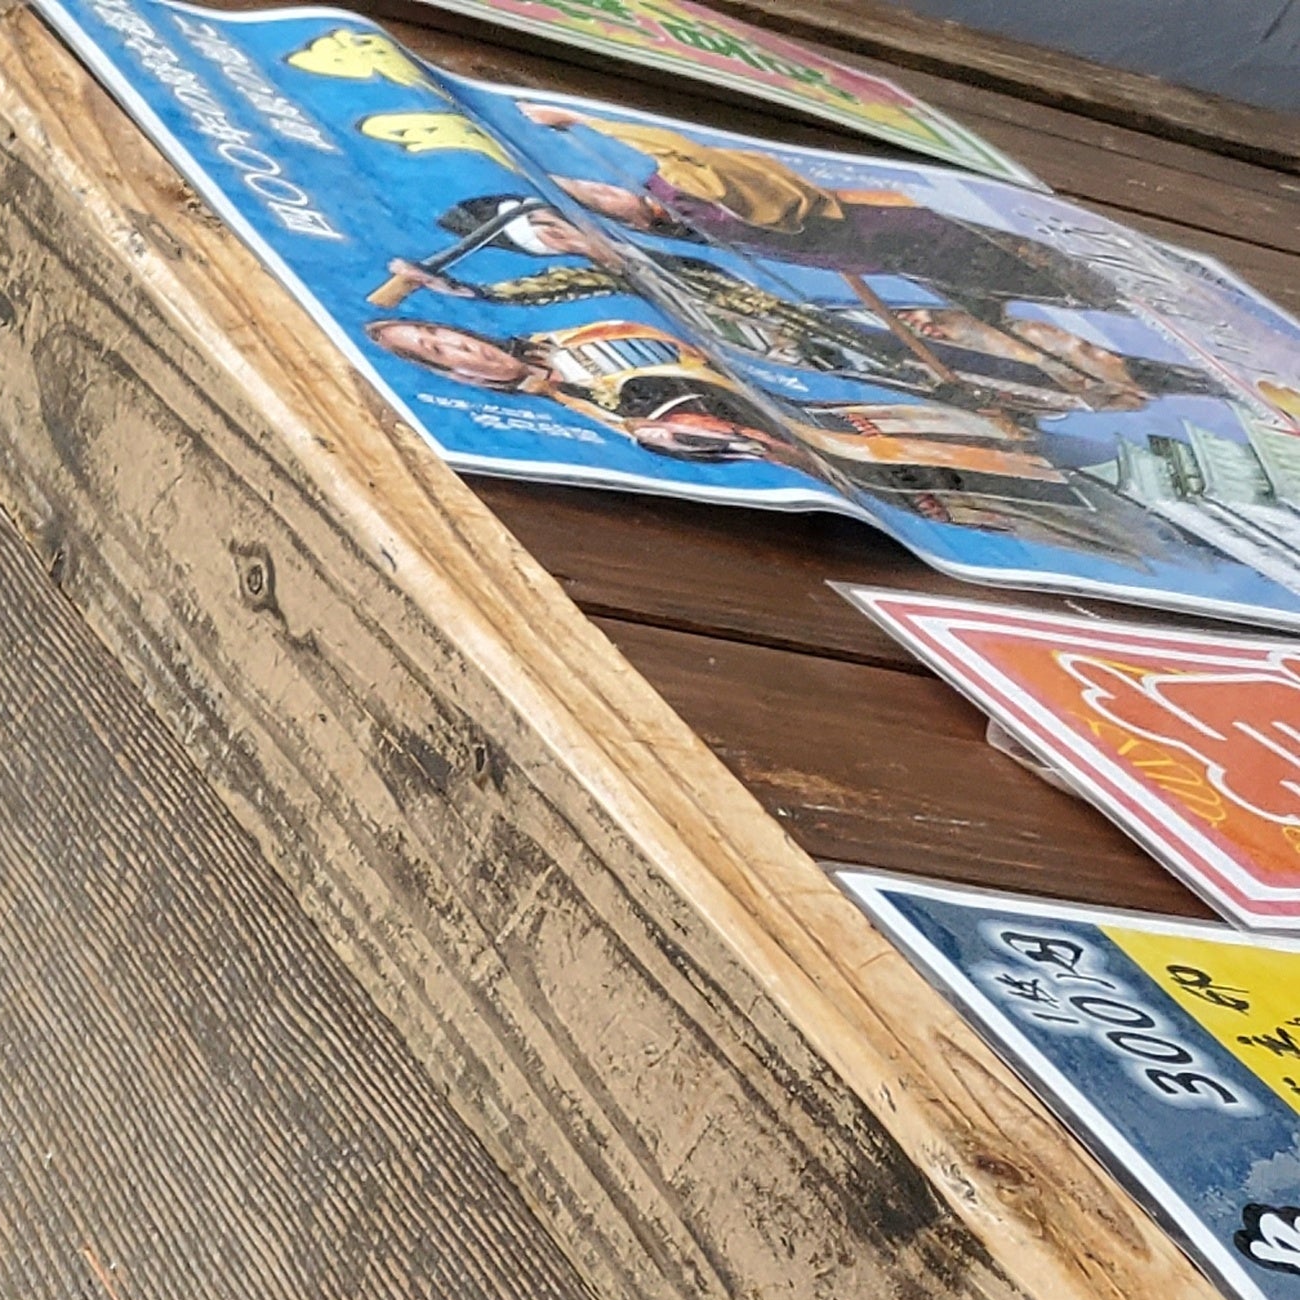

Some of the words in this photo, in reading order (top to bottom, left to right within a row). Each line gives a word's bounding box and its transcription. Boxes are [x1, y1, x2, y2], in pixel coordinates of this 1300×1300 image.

[994, 973, 1080, 1025] 1枚
[999, 931, 1239, 1104] 300円
[1164, 964, 1300, 1095] 主印
